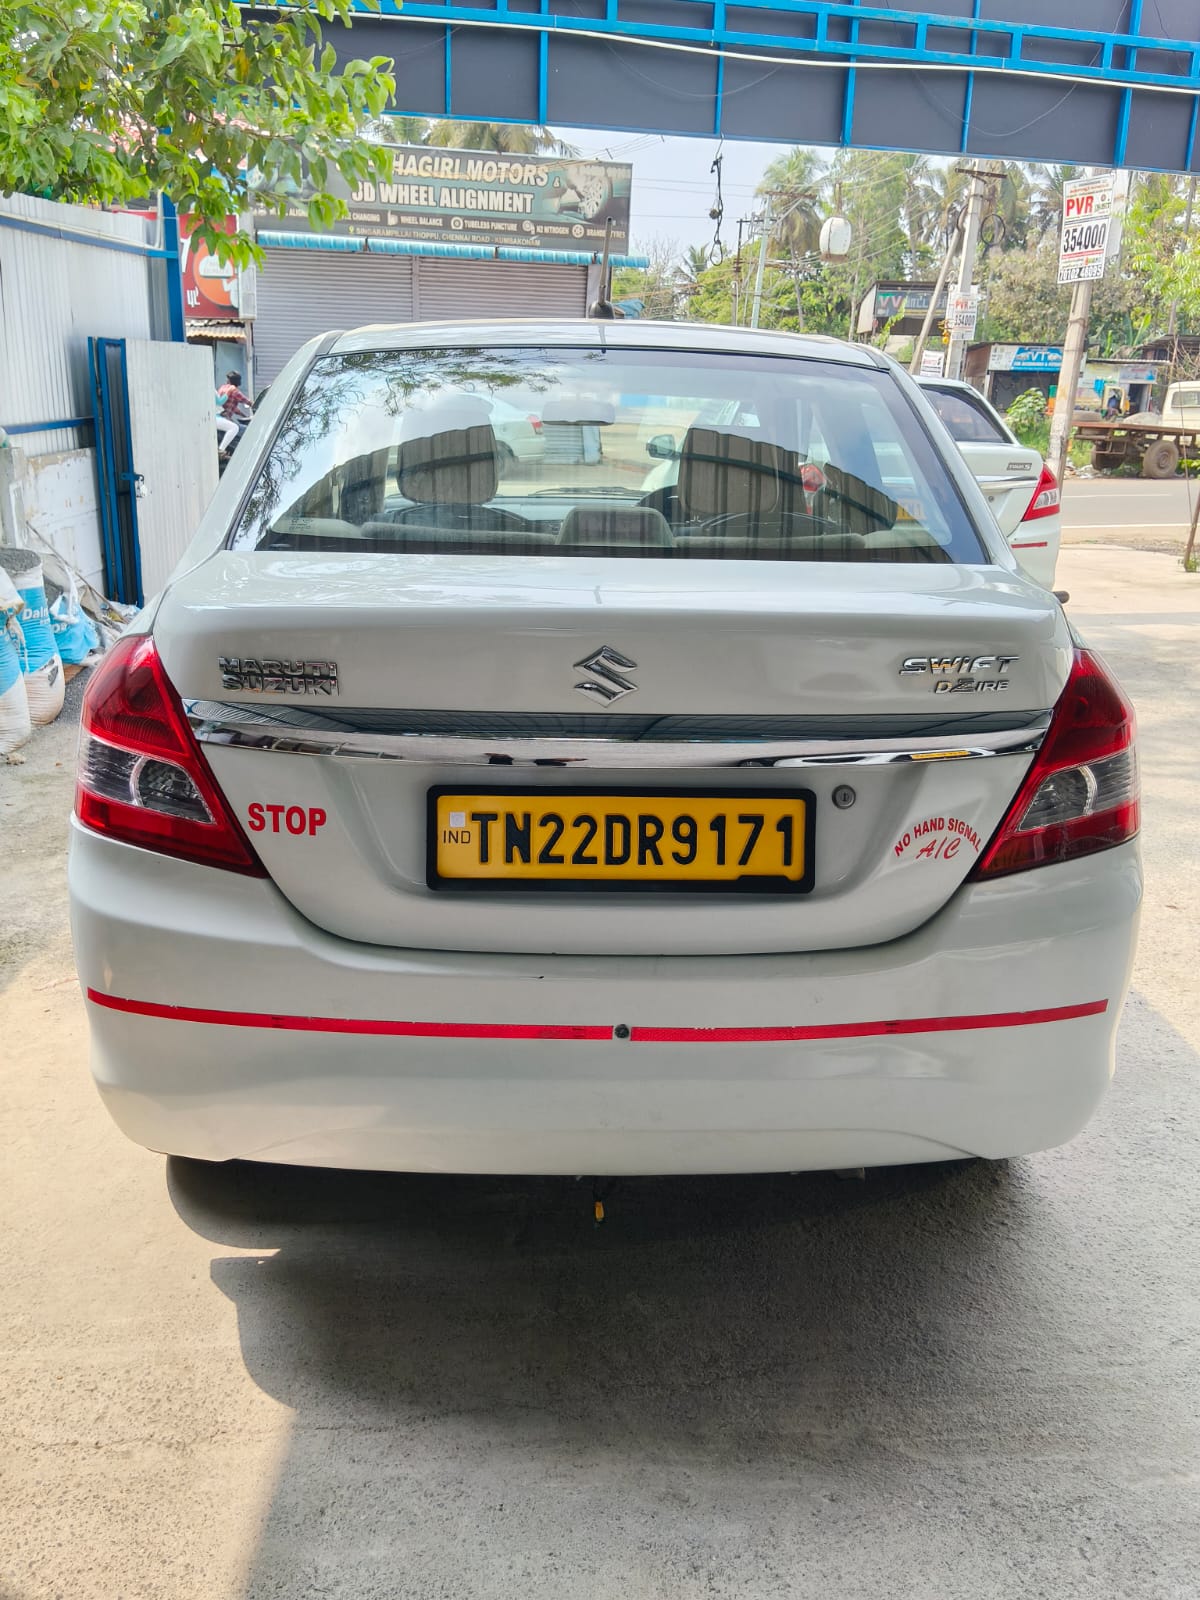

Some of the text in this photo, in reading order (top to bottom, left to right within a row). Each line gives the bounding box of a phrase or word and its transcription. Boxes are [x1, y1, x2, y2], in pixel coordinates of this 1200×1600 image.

[370, 152, 561, 188] HAGIRI MOTORS &
[379, 183, 437, 207] WHEEL
[440, 187, 535, 214] ALIGNMENT
[1066, 195, 1094, 217] PVR
[352, 212, 381, 222] CHANGING
[401, 215, 443, 226] WHEEL BALANCE
[464, 219, 518, 231] TUBELESS PUNCTURE
[441, 232, 471, 242] CHENNAI
[471, 234, 490, 243] ROAD
[544, 225, 570, 235] NITROGEN
[1063, 223, 1108, 253] 354000
[218, 656, 338, 677] MARUTI
[899, 655, 1020, 675] SWIFT
[222, 674, 339, 697] SUZUKI
[247, 802, 327, 837] STOP
[442, 829, 472, 845] IND
[471, 812, 794, 866] TN22DR9171
[894, 817, 982, 857] NO HAND SIGNAL
[915, 836, 961, 860] A/C
